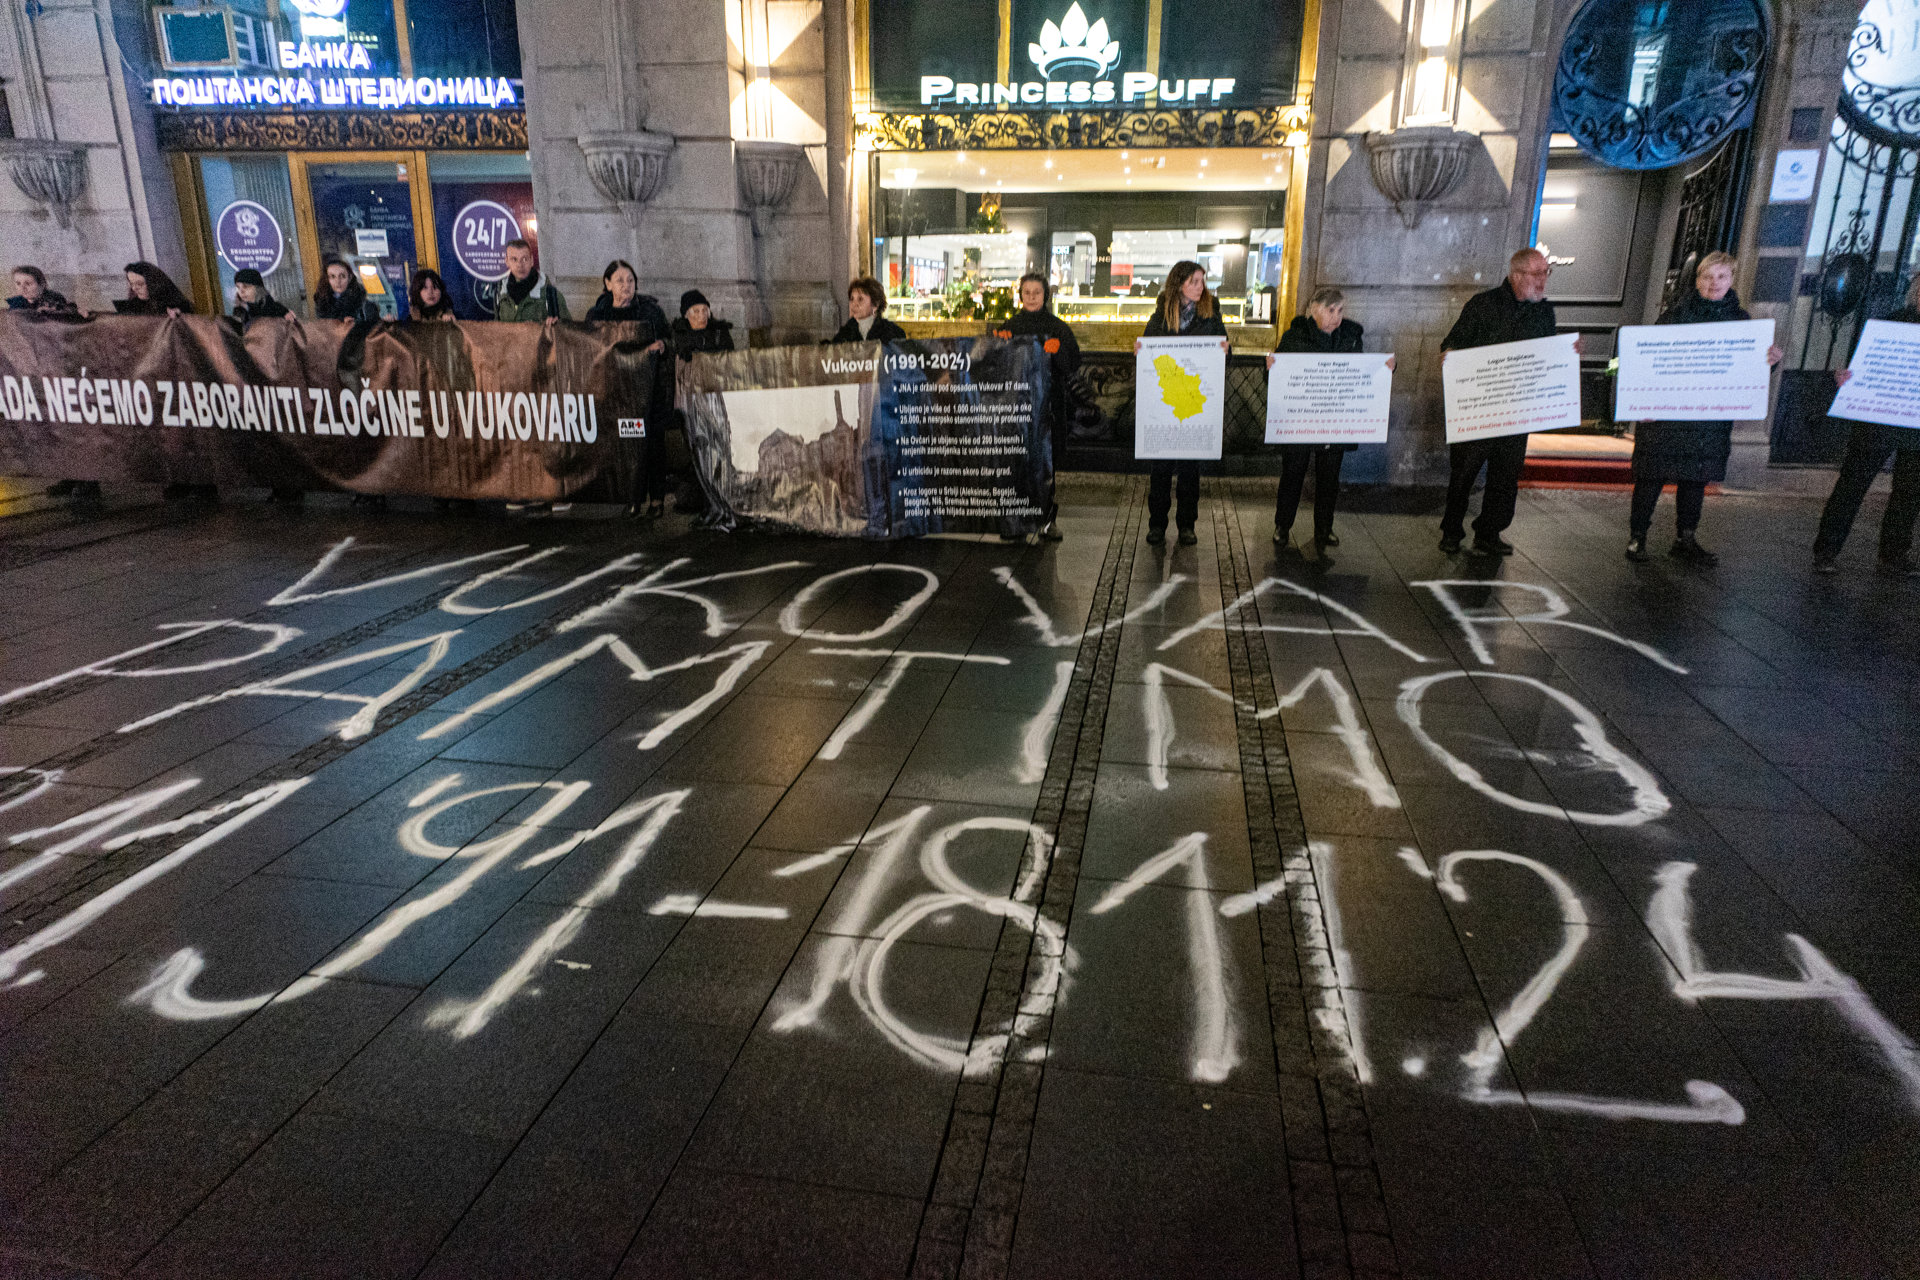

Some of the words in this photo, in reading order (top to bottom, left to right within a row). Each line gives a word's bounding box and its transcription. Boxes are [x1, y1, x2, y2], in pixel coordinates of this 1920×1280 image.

[279, 41, 370, 69] БАНКА
[153, 77, 315, 105] ПОШТАНСКА
[320, 77, 515, 109] ШТЕДИОНИЦА
[465, 217, 507, 250] 24/7
[821, 357, 880, 374] Vukovar
[884, 352, 971, 374] (1991-2024)
[979, 382, 1003, 391] Vukovar
[42, 367, 154, 427] NEĆEMO
[157, 380, 307, 434] ZABORAVITI
[308, 378, 425, 437] ZLOČINE
[429, 390, 450, 439] U
[455, 391, 598, 444] VUKOVARU
[902, 467, 907, 476] U
[267, 535, 1690, 675] VUKOVAR
[0, 613, 1673, 826] PAMTIMO
